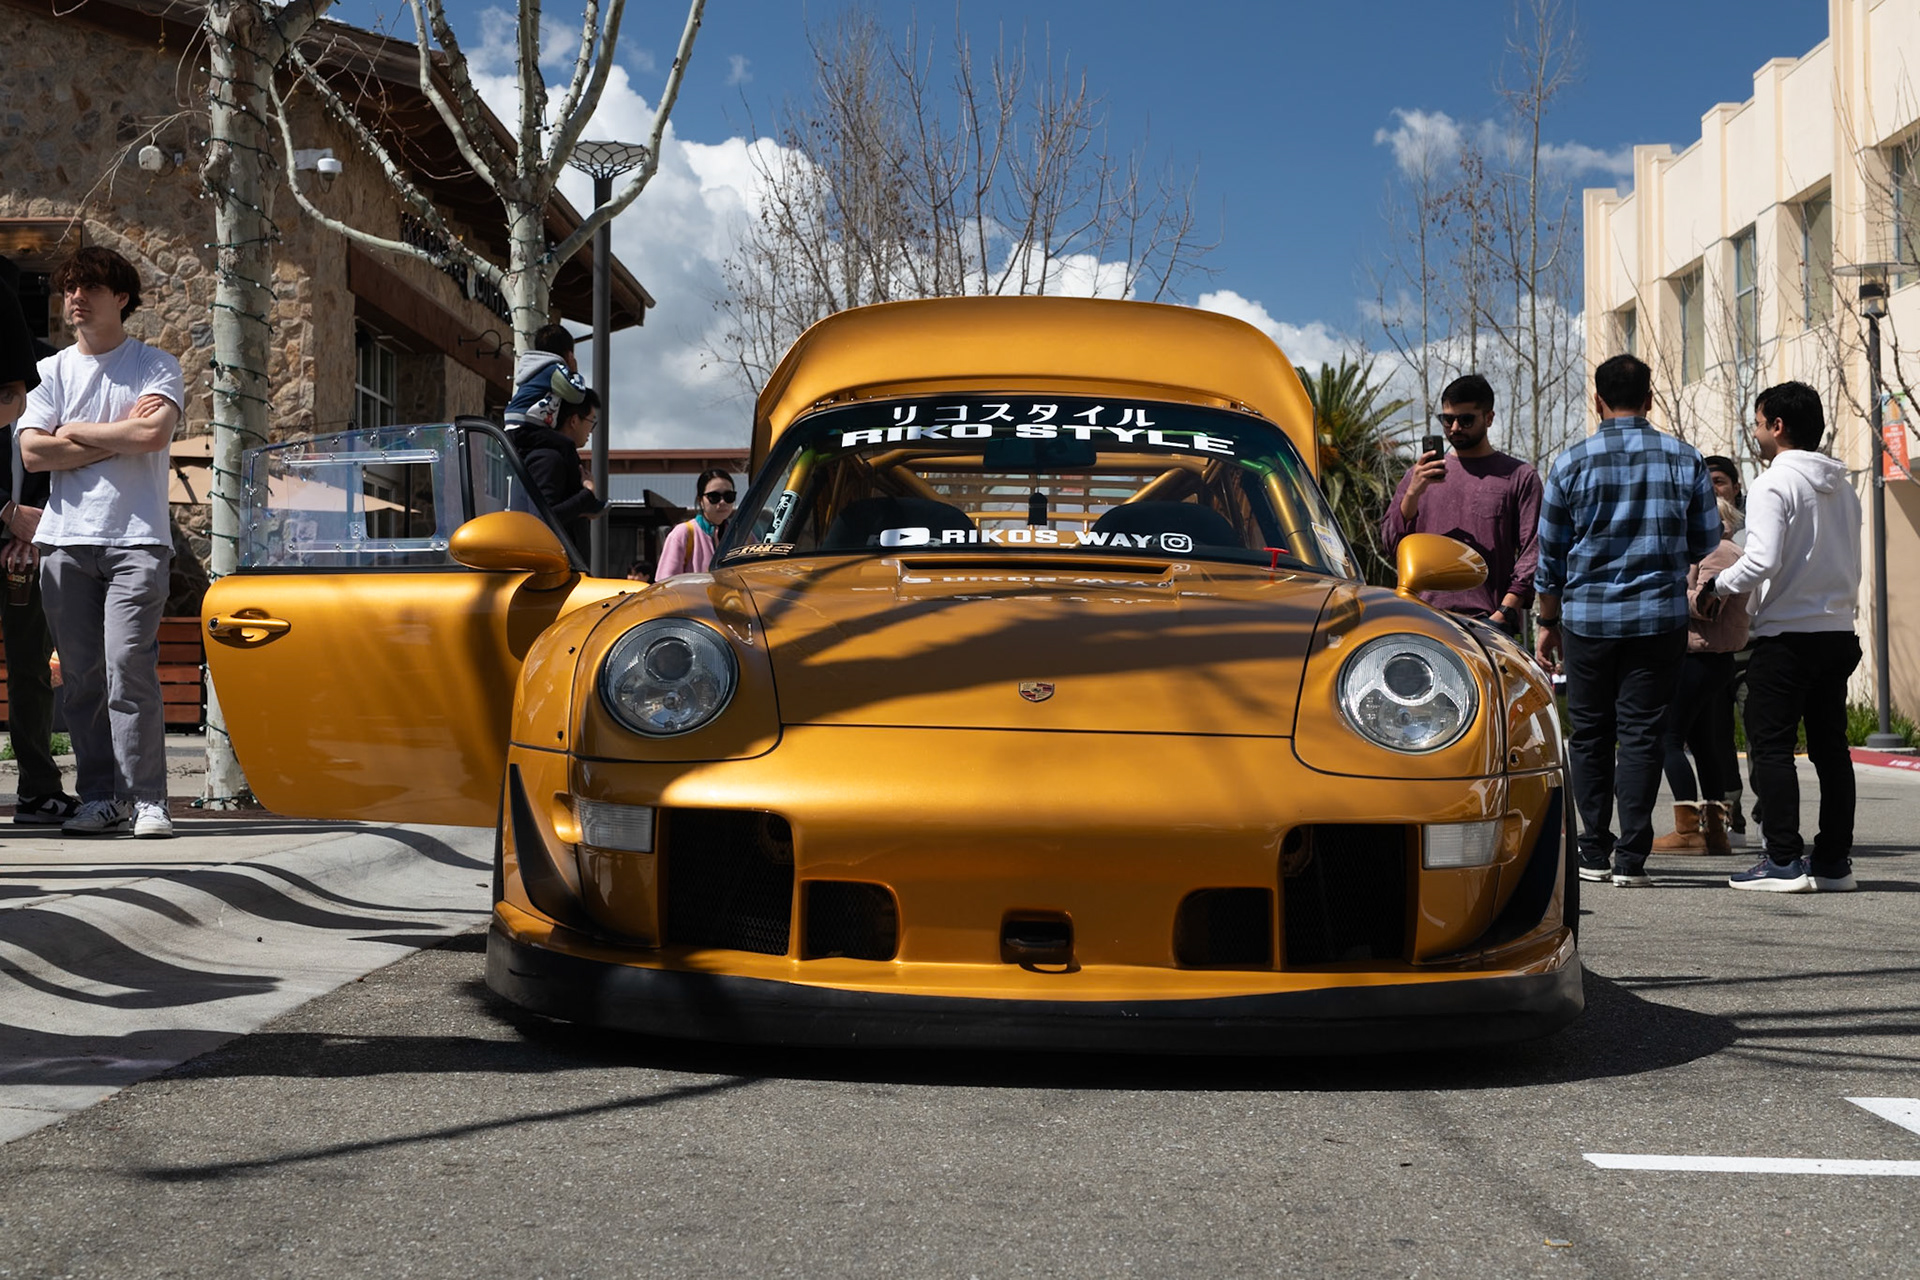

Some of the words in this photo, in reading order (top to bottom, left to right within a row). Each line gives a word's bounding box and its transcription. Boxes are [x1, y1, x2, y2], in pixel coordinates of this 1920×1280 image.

[893, 403, 1156, 427] リコスタイル
[841, 424, 993, 447] RIKO
[1015, 424, 1235, 456] STYLE
[941, 529, 1153, 549] RIKOS_WAY
